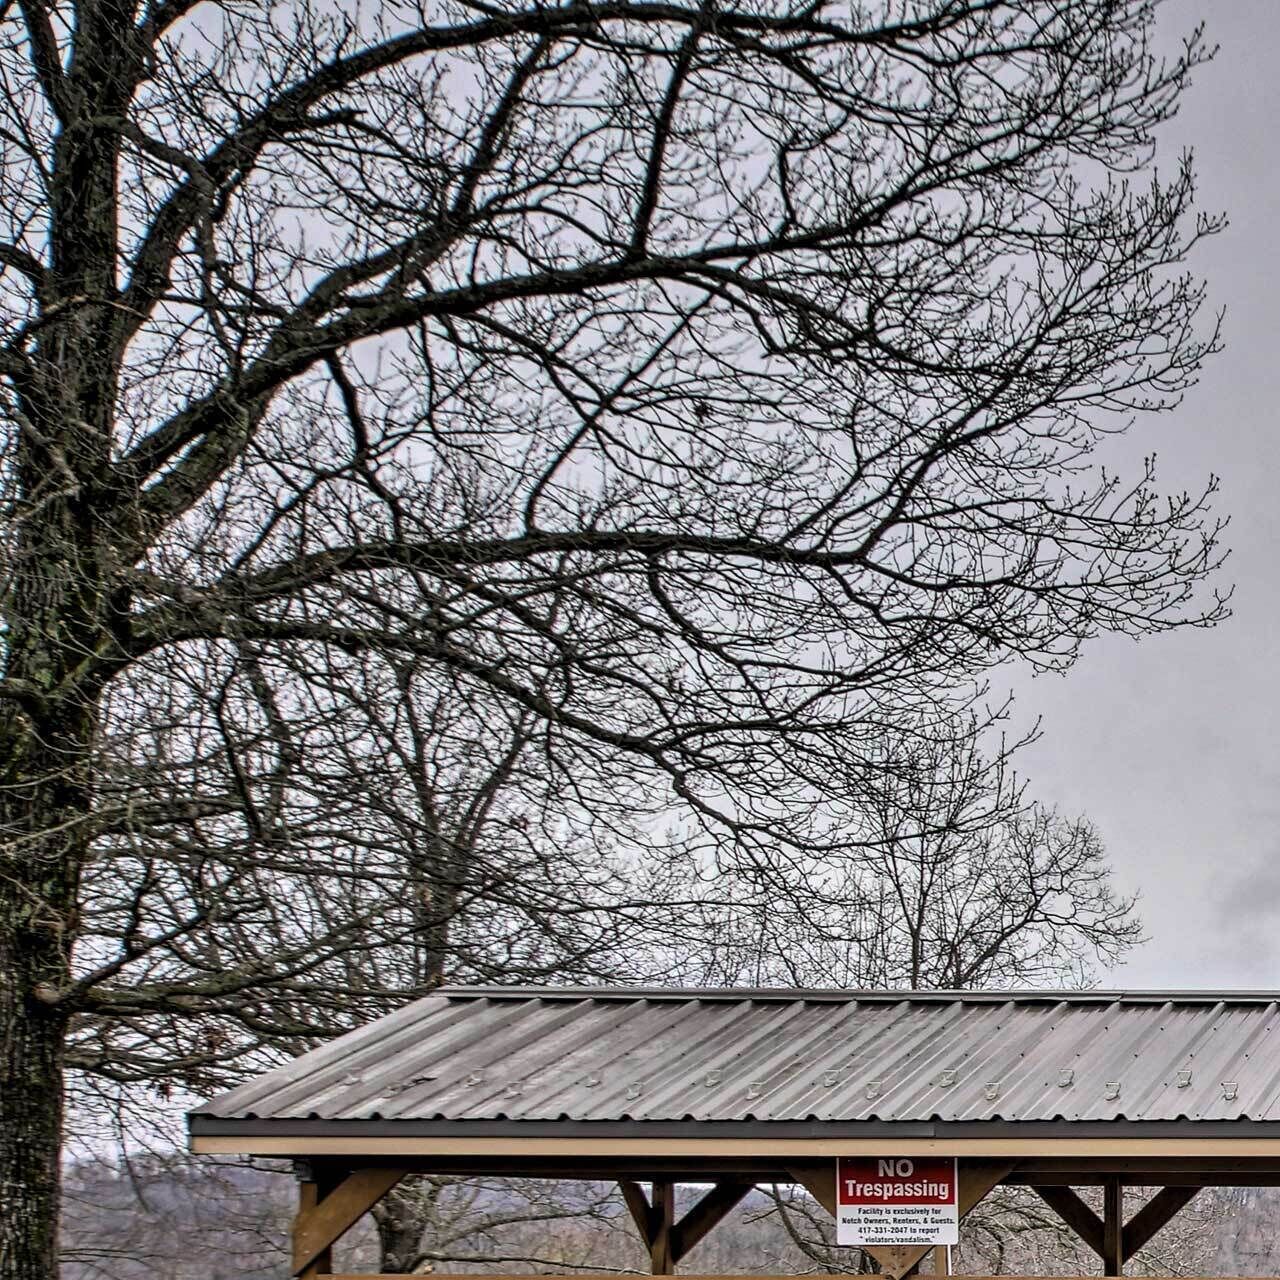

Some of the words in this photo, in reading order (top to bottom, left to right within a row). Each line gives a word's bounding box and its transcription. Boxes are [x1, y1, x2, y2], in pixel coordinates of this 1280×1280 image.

[878, 1159, 914, 1177] NO
[845, 1179, 949, 1200] Trespassing
[858, 1207, 883, 1215] Facility
[893, 1207, 930, 1215] exclusively
[858, 1226, 908, 1234] 417-331-2047
